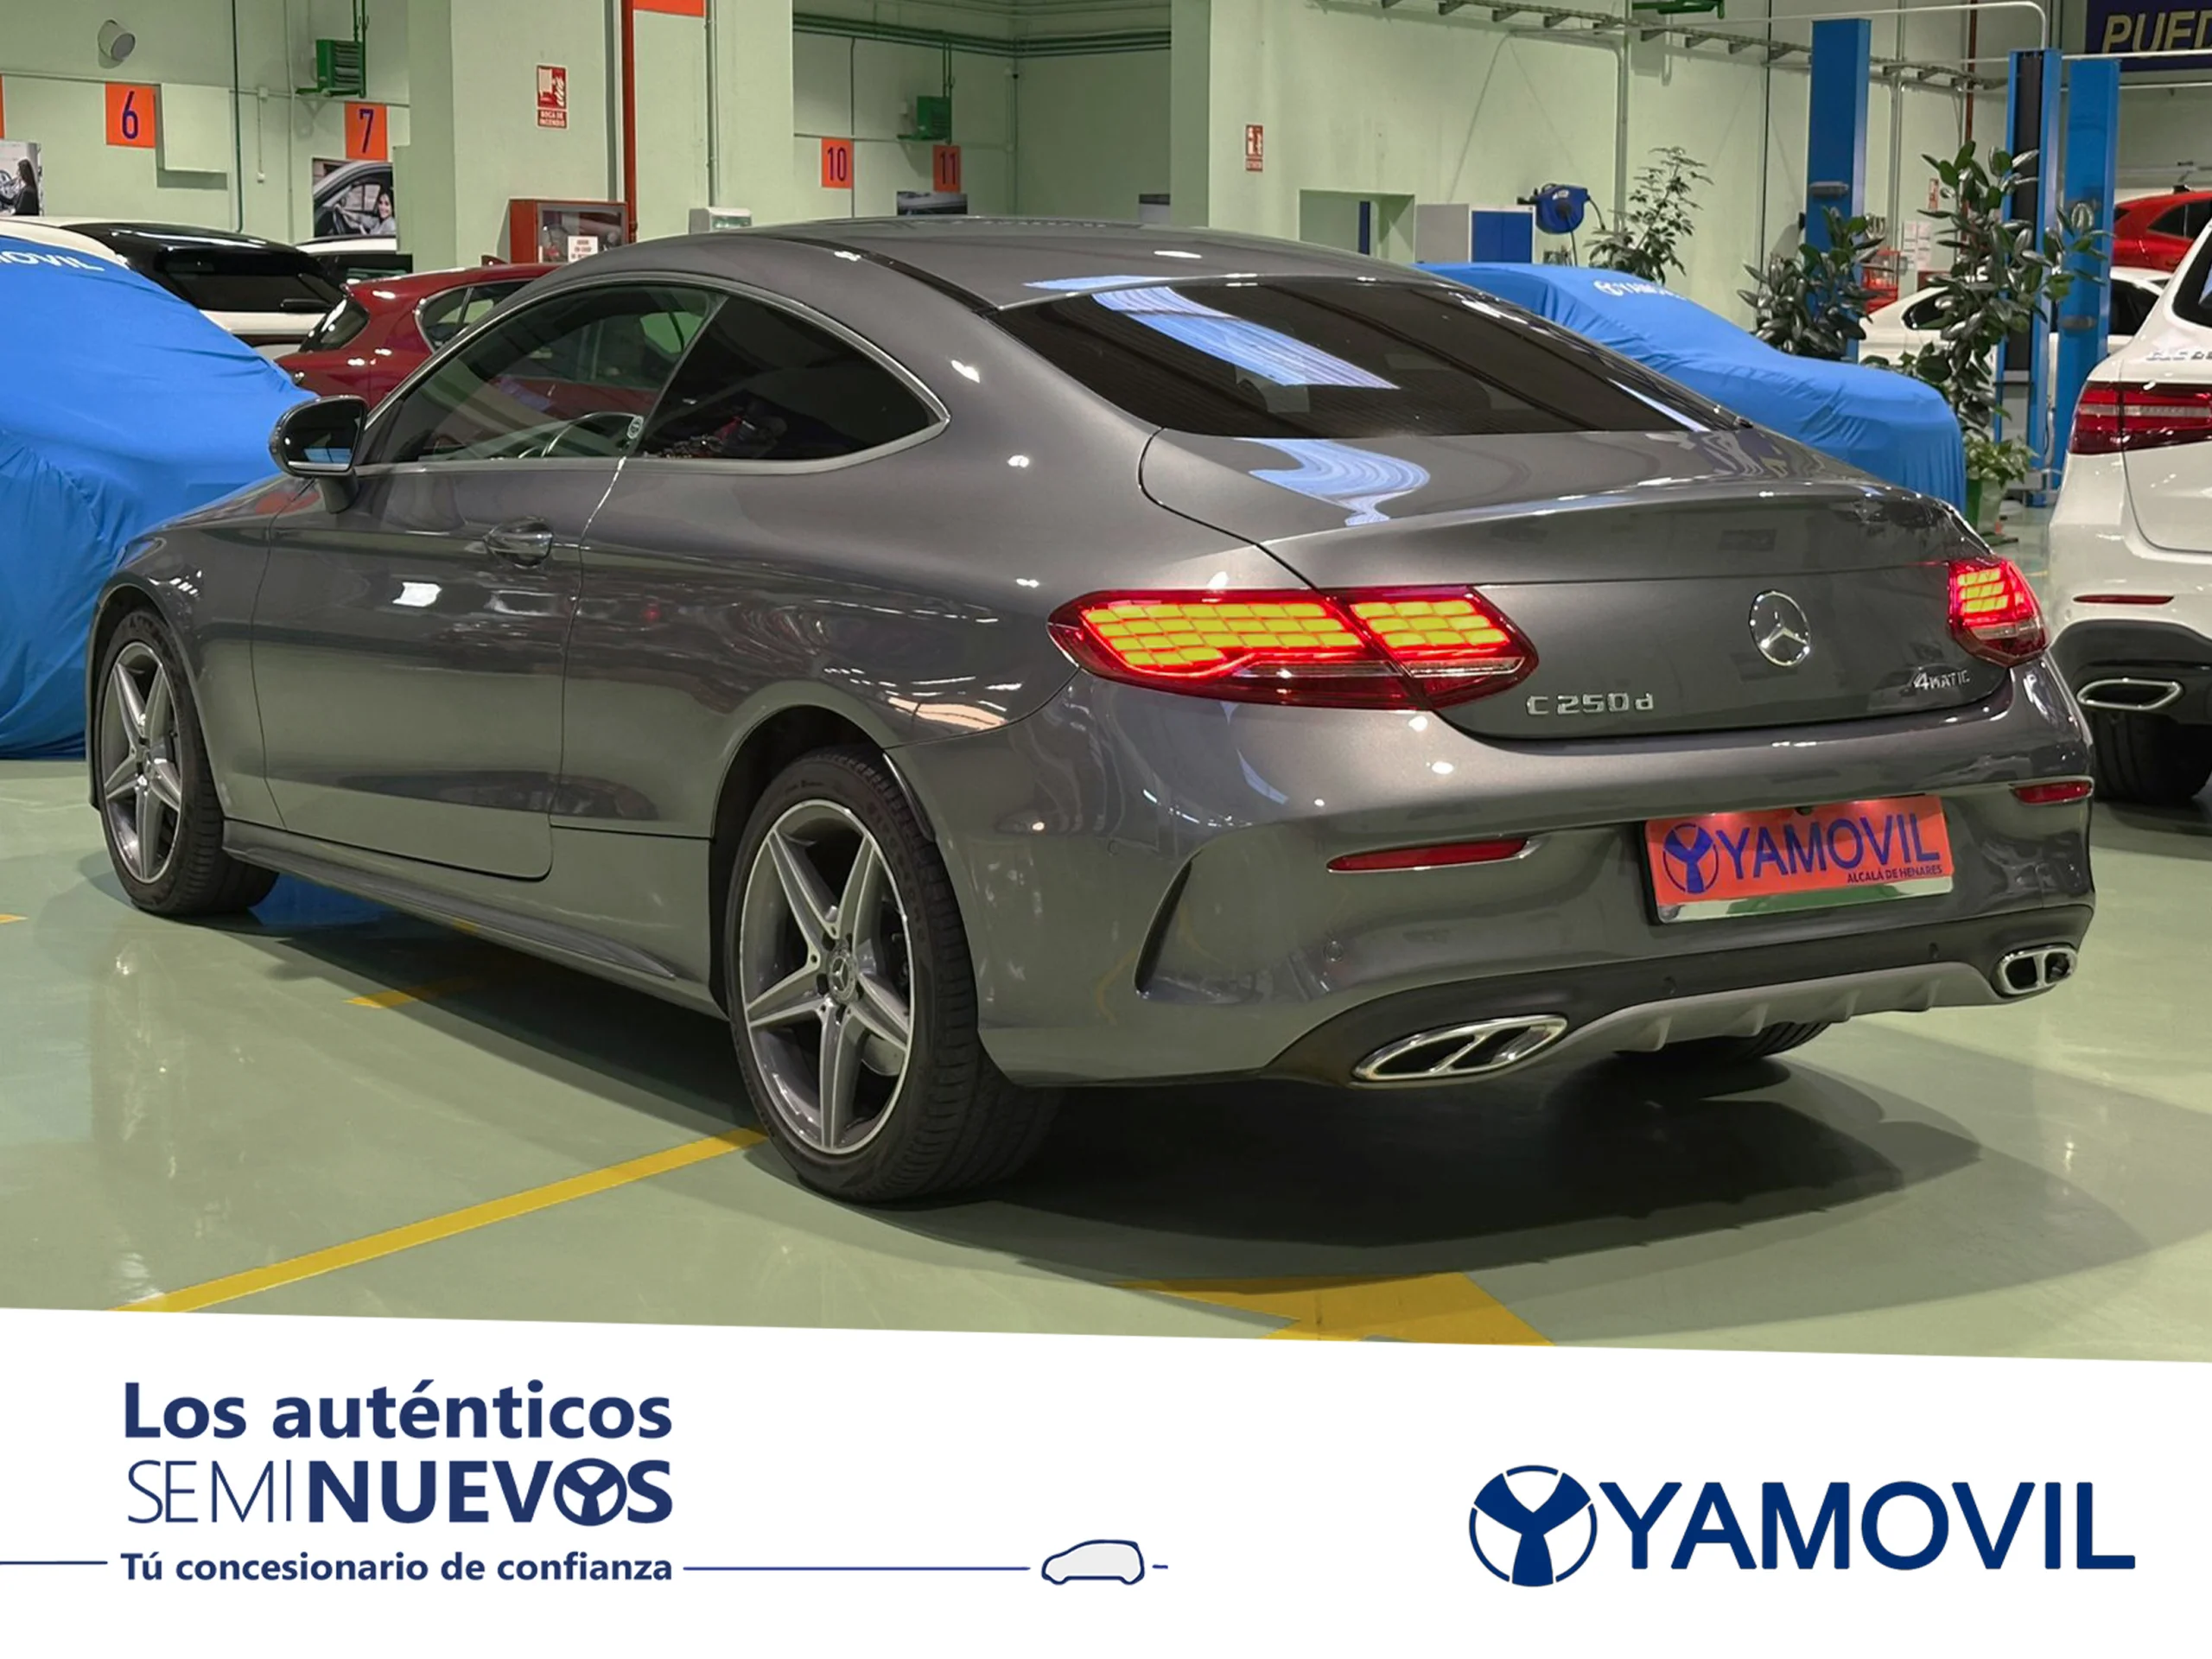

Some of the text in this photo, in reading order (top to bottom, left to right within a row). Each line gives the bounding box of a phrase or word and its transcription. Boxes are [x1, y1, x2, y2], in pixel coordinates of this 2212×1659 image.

[122, 90, 138, 139] 6
[359, 108, 373, 154] 7
[827, 146, 847, 181] 10
[940, 150, 956, 185] 11
[1913, 670, 1970, 690] 4MATIC
[1527, 692, 1654, 715] C 250 d
[1715, 812, 1941, 880] YAMOVIL
[1847, 865, 1942, 883] ALCALÁ DE HENARES
